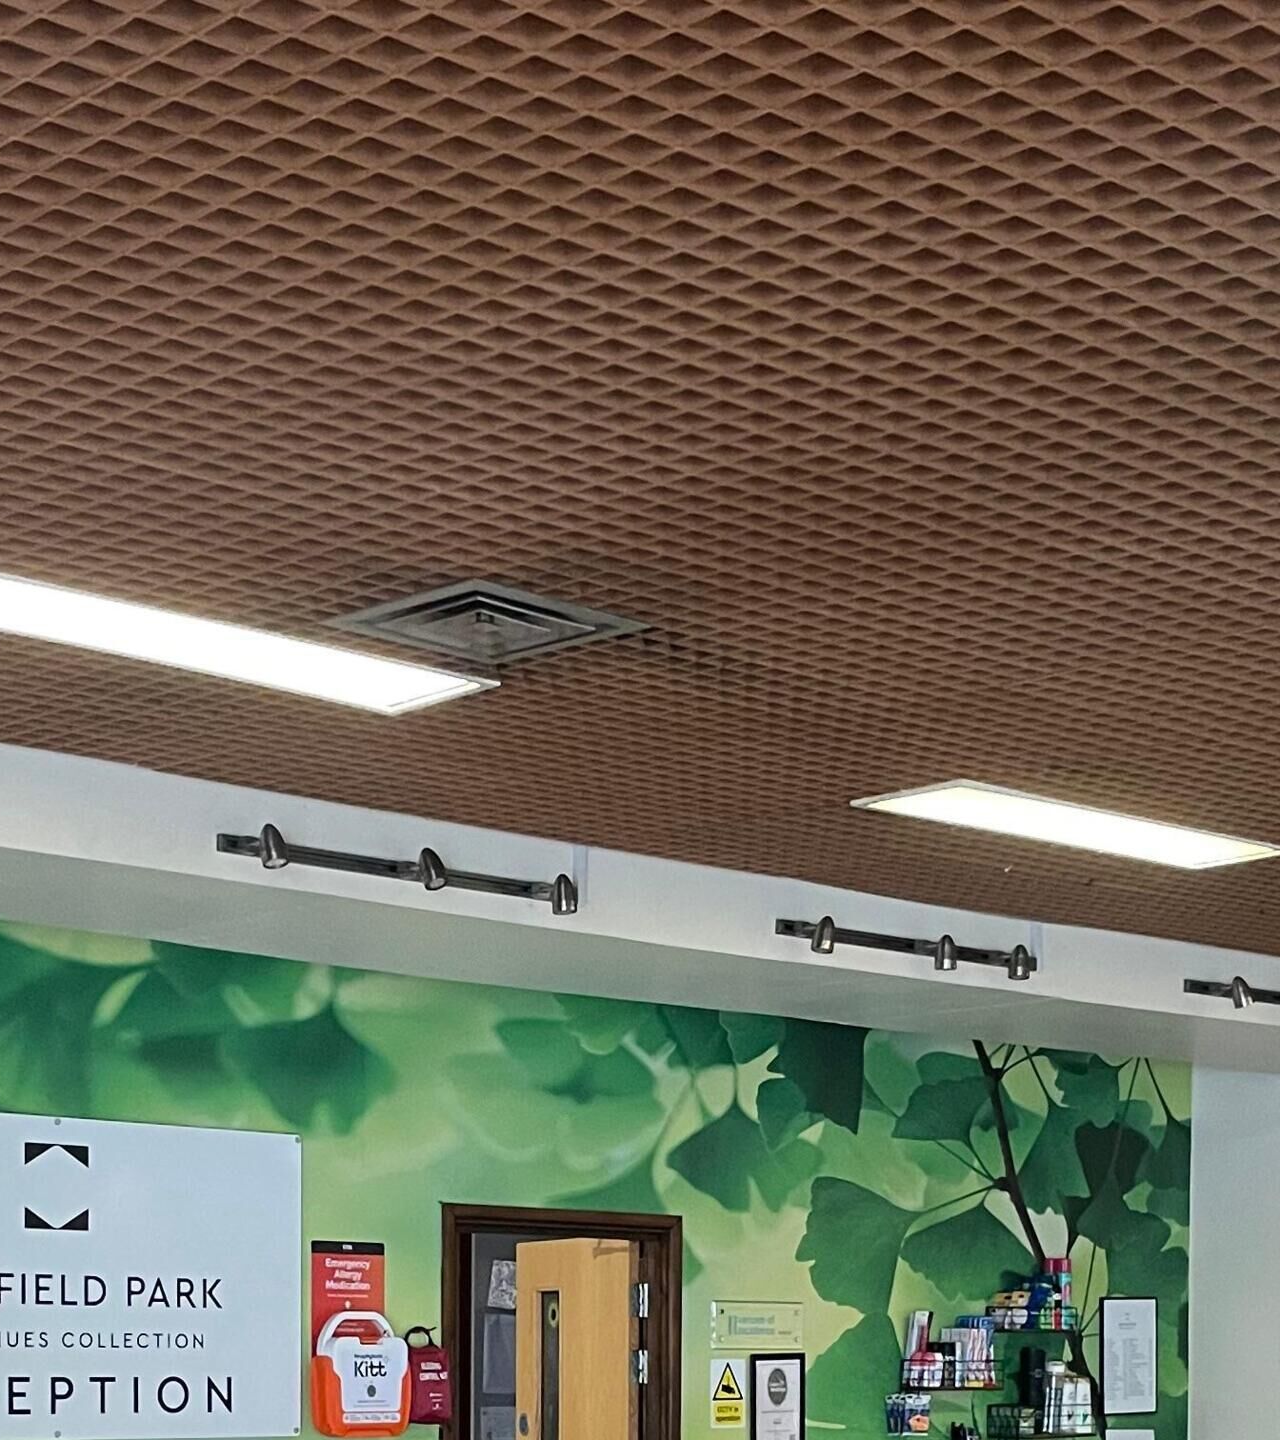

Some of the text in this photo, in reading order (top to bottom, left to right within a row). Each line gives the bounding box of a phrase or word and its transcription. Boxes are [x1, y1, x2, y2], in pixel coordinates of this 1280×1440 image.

[325, 1258, 370, 1270] Emergency
[334, 1270, 362, 1281] Allergy
[325, 1280, 370, 1290] Medication
[127, 1276, 223, 1309] PARK
[62, 1332, 205, 1349] COLLECTION
[354, 1361, 387, 1377] Kitt
